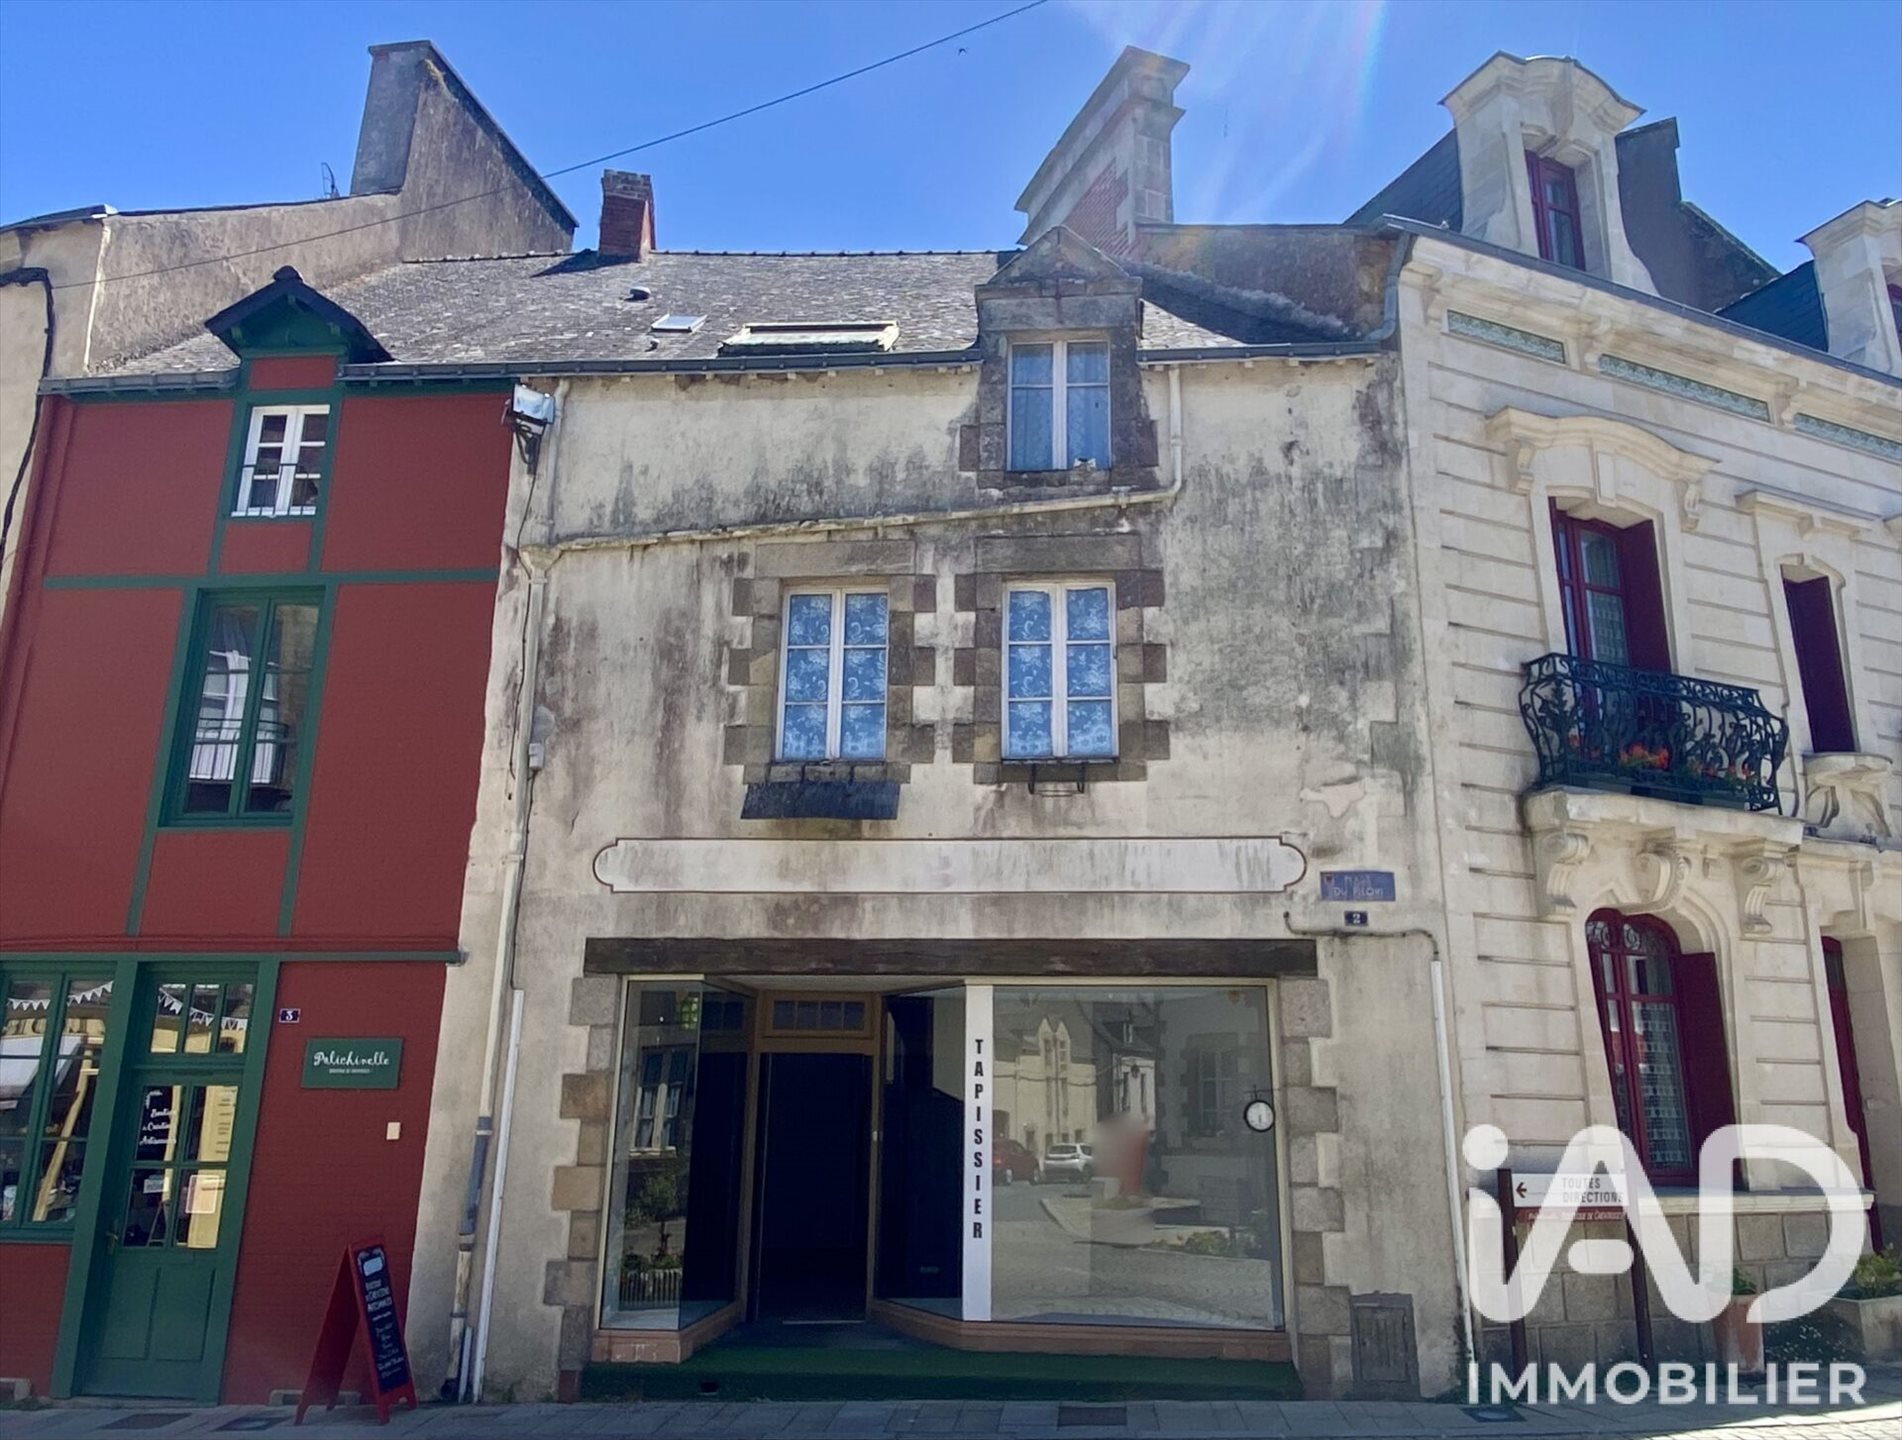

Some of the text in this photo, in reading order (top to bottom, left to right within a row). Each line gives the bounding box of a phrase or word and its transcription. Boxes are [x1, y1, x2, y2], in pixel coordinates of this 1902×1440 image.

[1352, 913, 1361, 924] 2
[972, 1039, 984, 1239] TAPISSIER
[1561, 1177, 1601, 1190] TOUTES
